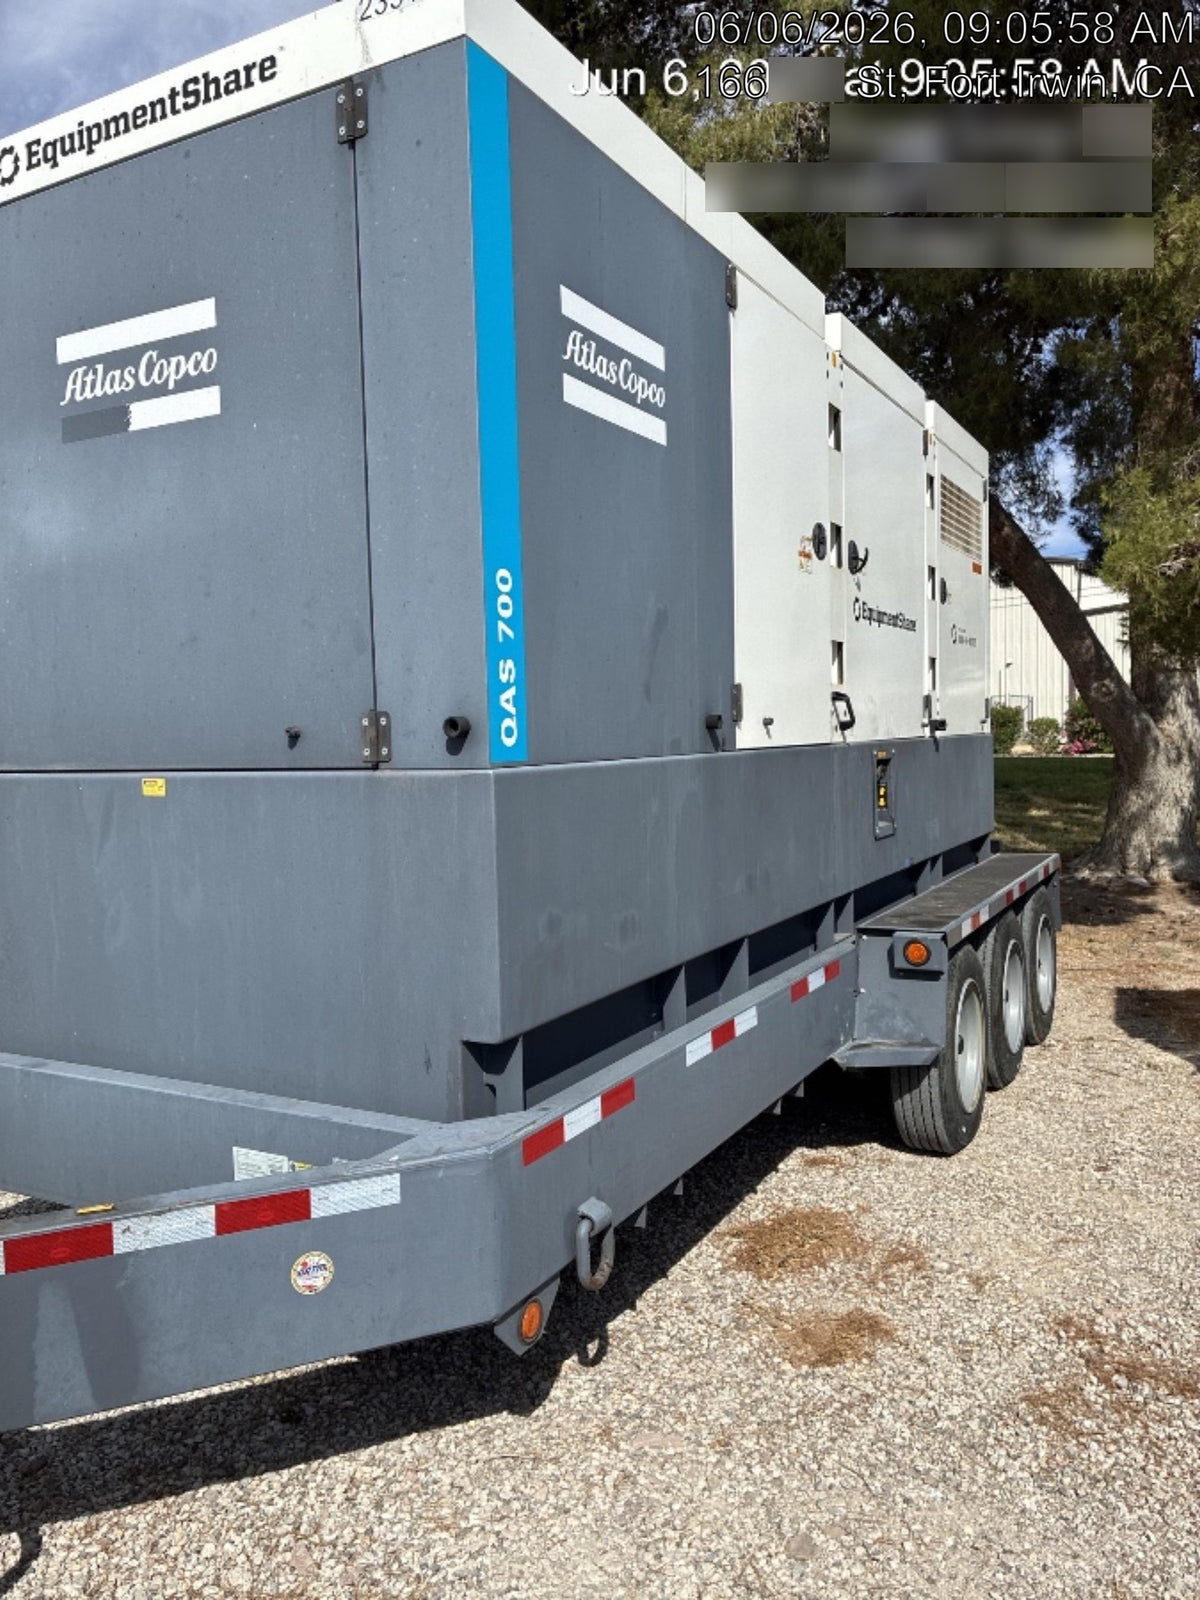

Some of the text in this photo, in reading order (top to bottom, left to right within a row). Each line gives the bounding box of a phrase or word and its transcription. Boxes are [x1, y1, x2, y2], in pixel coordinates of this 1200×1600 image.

[26, 54, 278, 169] EquipmentShare
[495, 568, 518, 747] QAS 700
